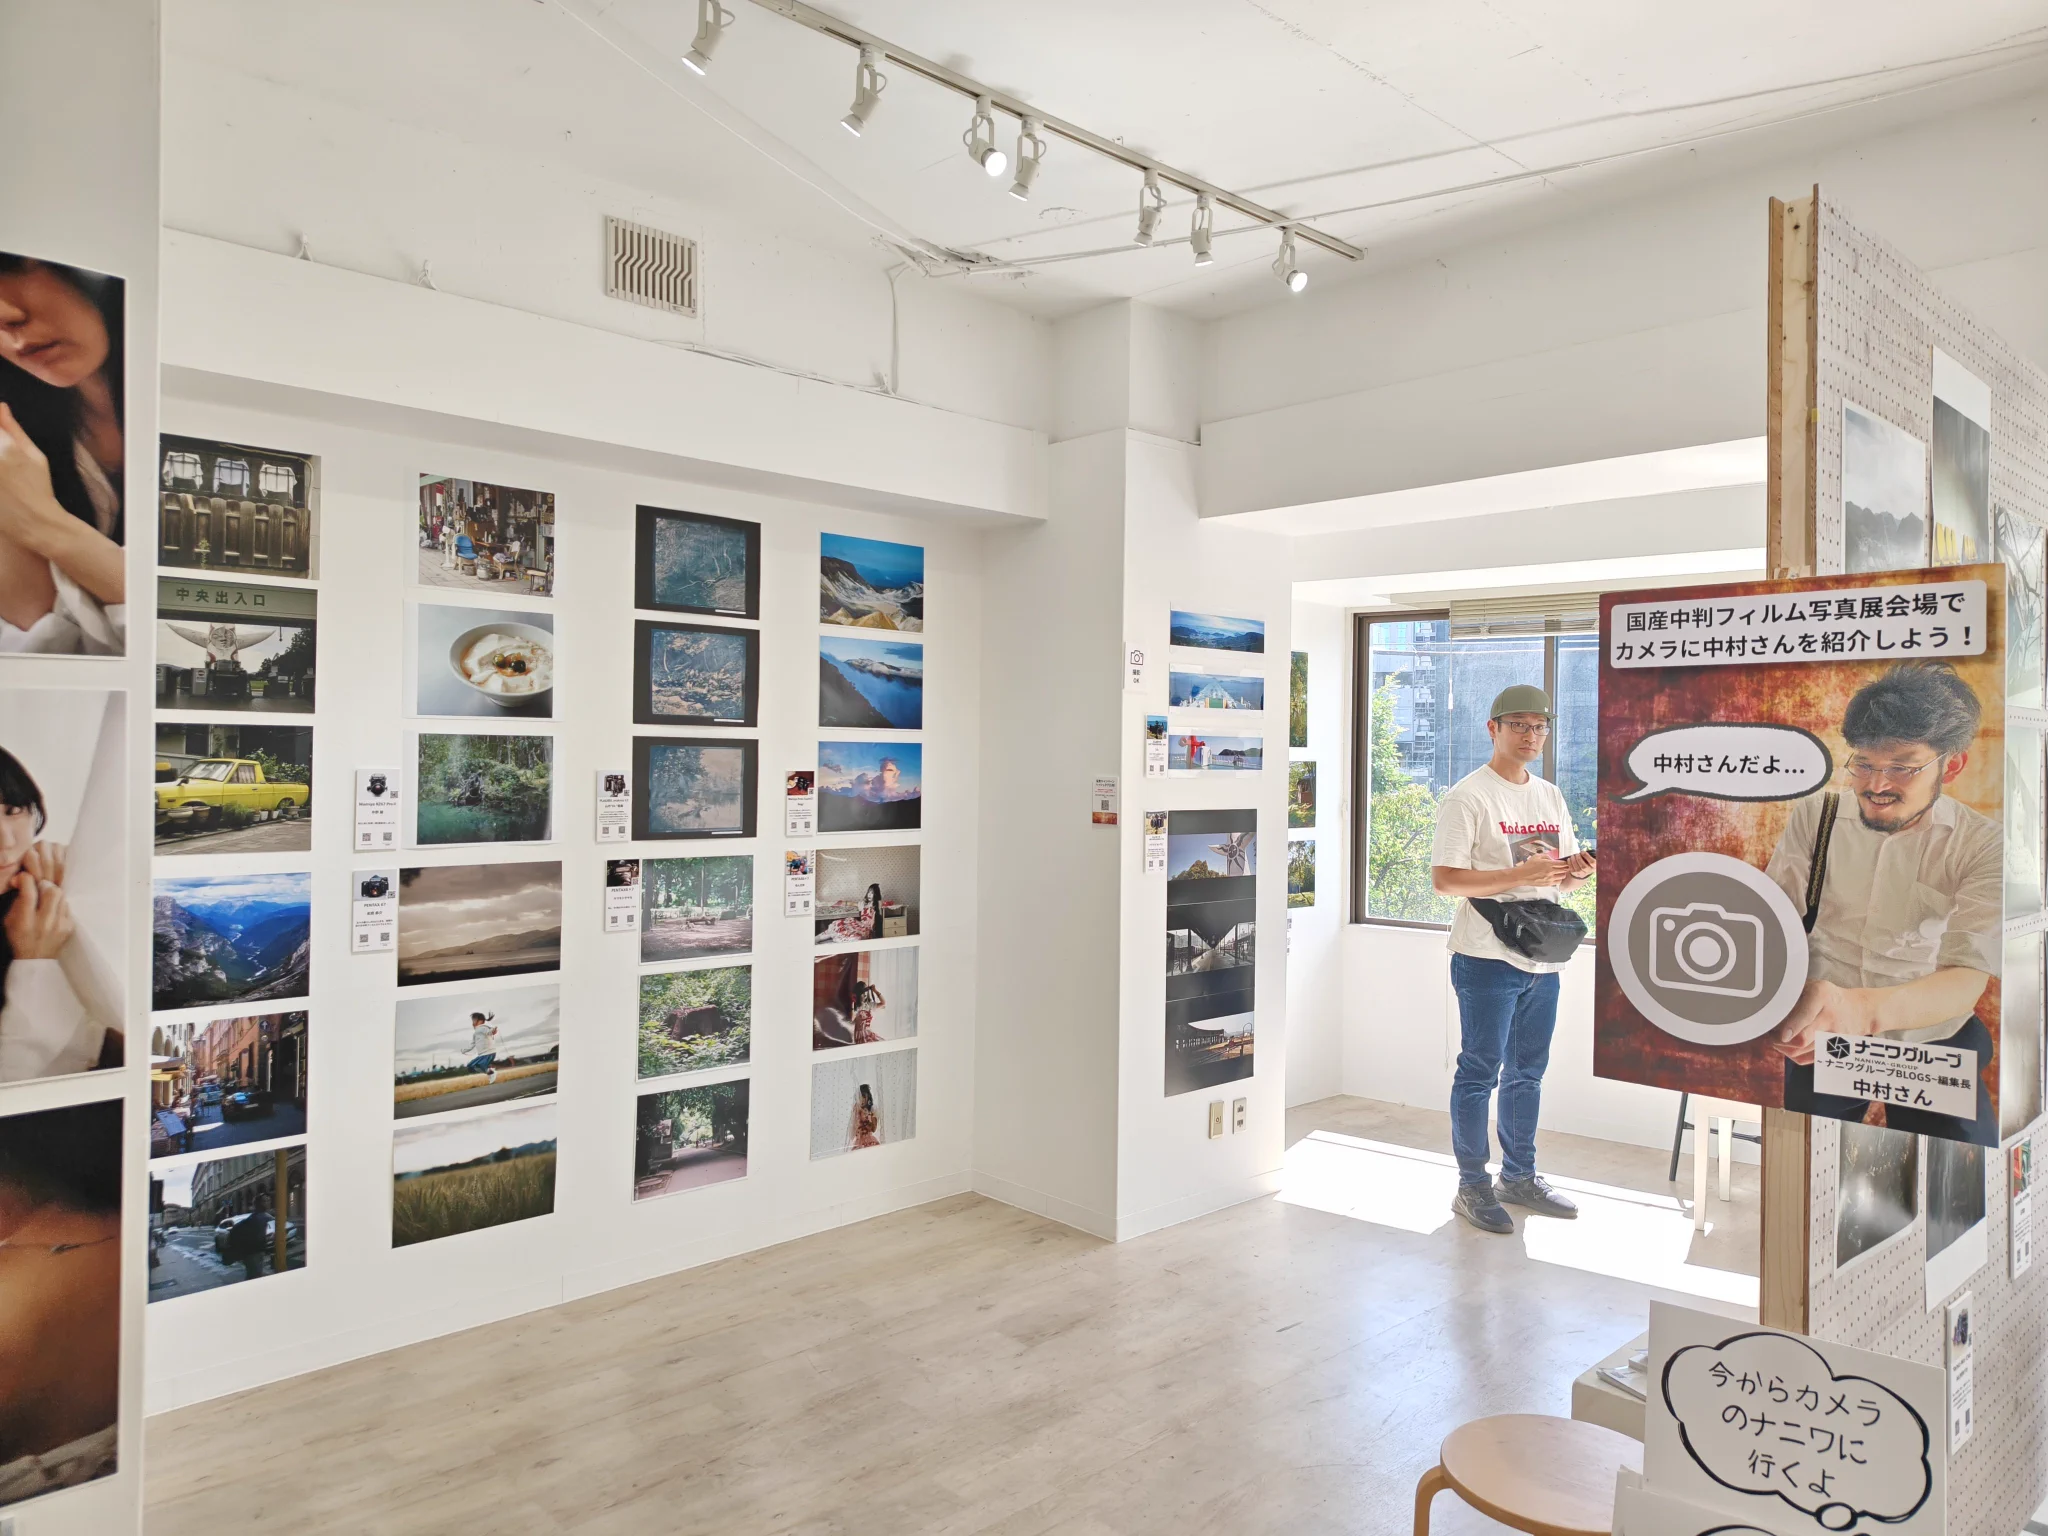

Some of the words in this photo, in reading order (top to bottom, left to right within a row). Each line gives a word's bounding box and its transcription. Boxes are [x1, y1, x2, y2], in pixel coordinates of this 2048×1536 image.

[176, 587, 266, 607] 中央出入口
[1626, 591, 1965, 632] 国産中判フィルム写真展会場で
[1616, 625, 1972, 661] カメラに中村さんを紹介しよう！
[1854, 1040, 1962, 1069] ナニワグループ
[1853, 1078, 1933, 1107] 中村さん
[1708, 1360, 1882, 1427] 今からカメラ
[1721, 1404, 1868, 1465] のナニワに
[1747, 1449, 1836, 1498] 行くよ
